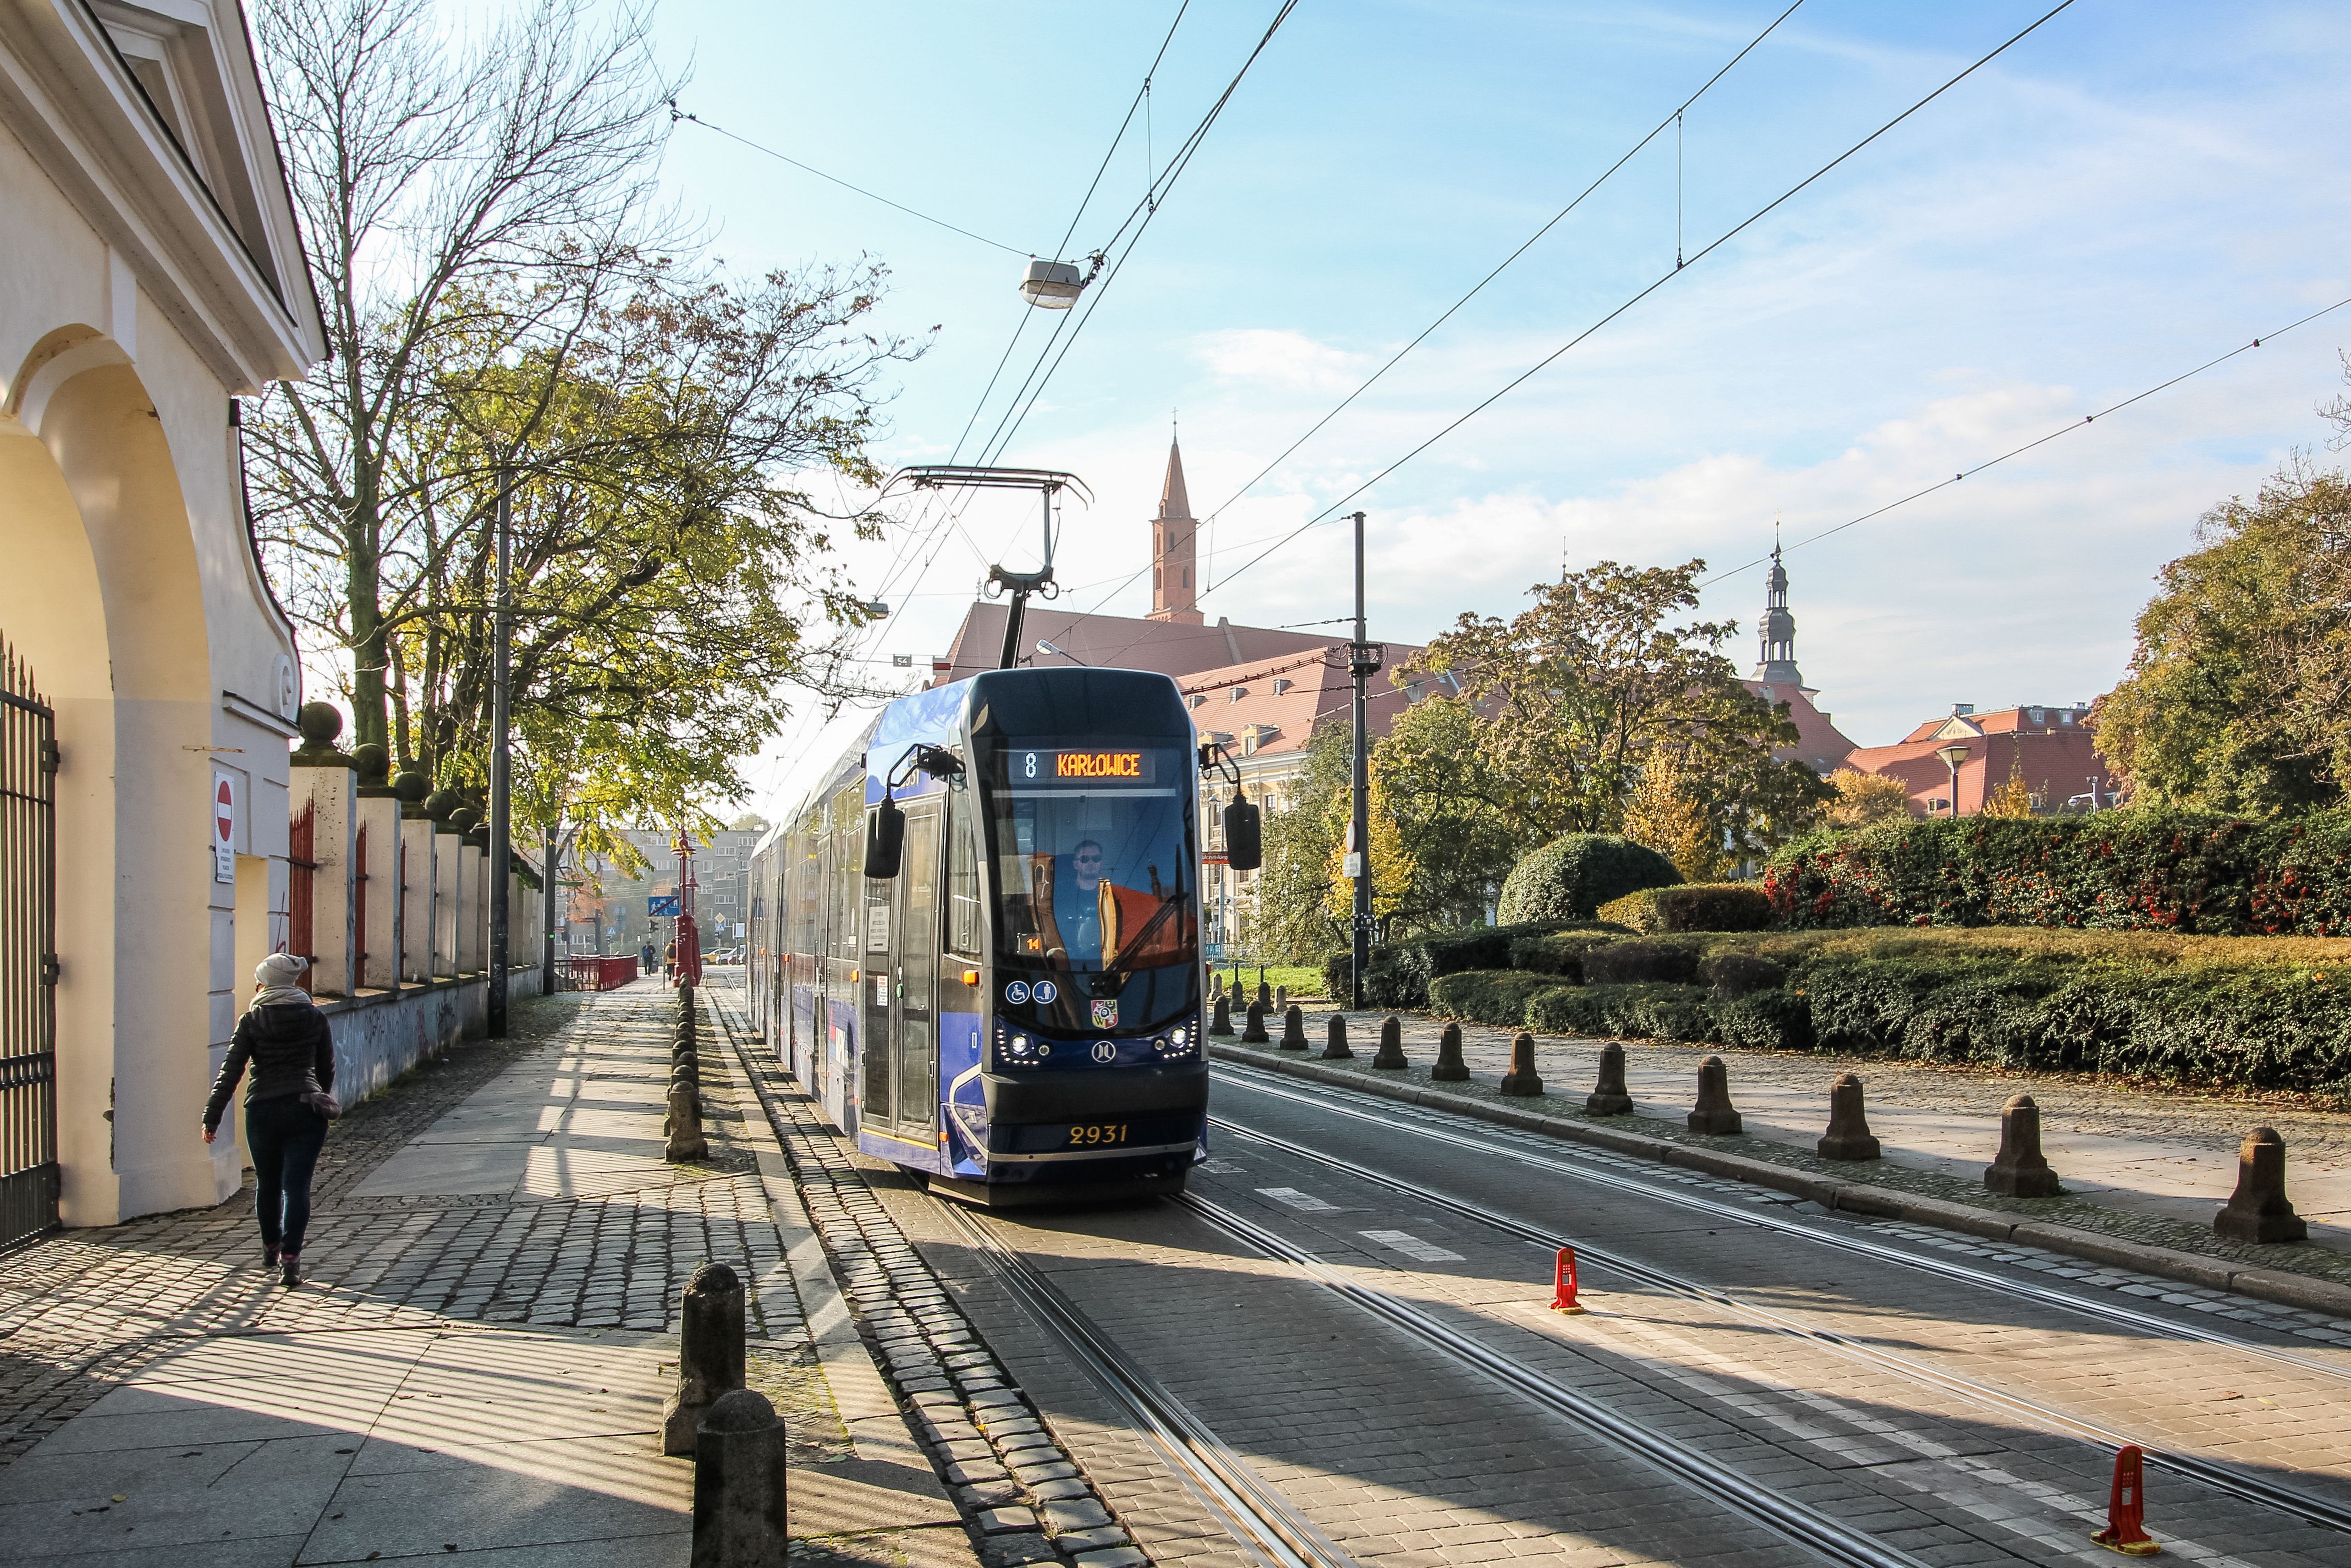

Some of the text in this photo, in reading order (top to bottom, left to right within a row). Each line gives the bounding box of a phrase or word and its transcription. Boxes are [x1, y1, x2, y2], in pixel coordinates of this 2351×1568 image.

[1025, 752, 1141, 779] 8 KARŁOWICE
[1027, 938, 1040, 950] 14
[1070, 1124, 1127, 1144] 2931
